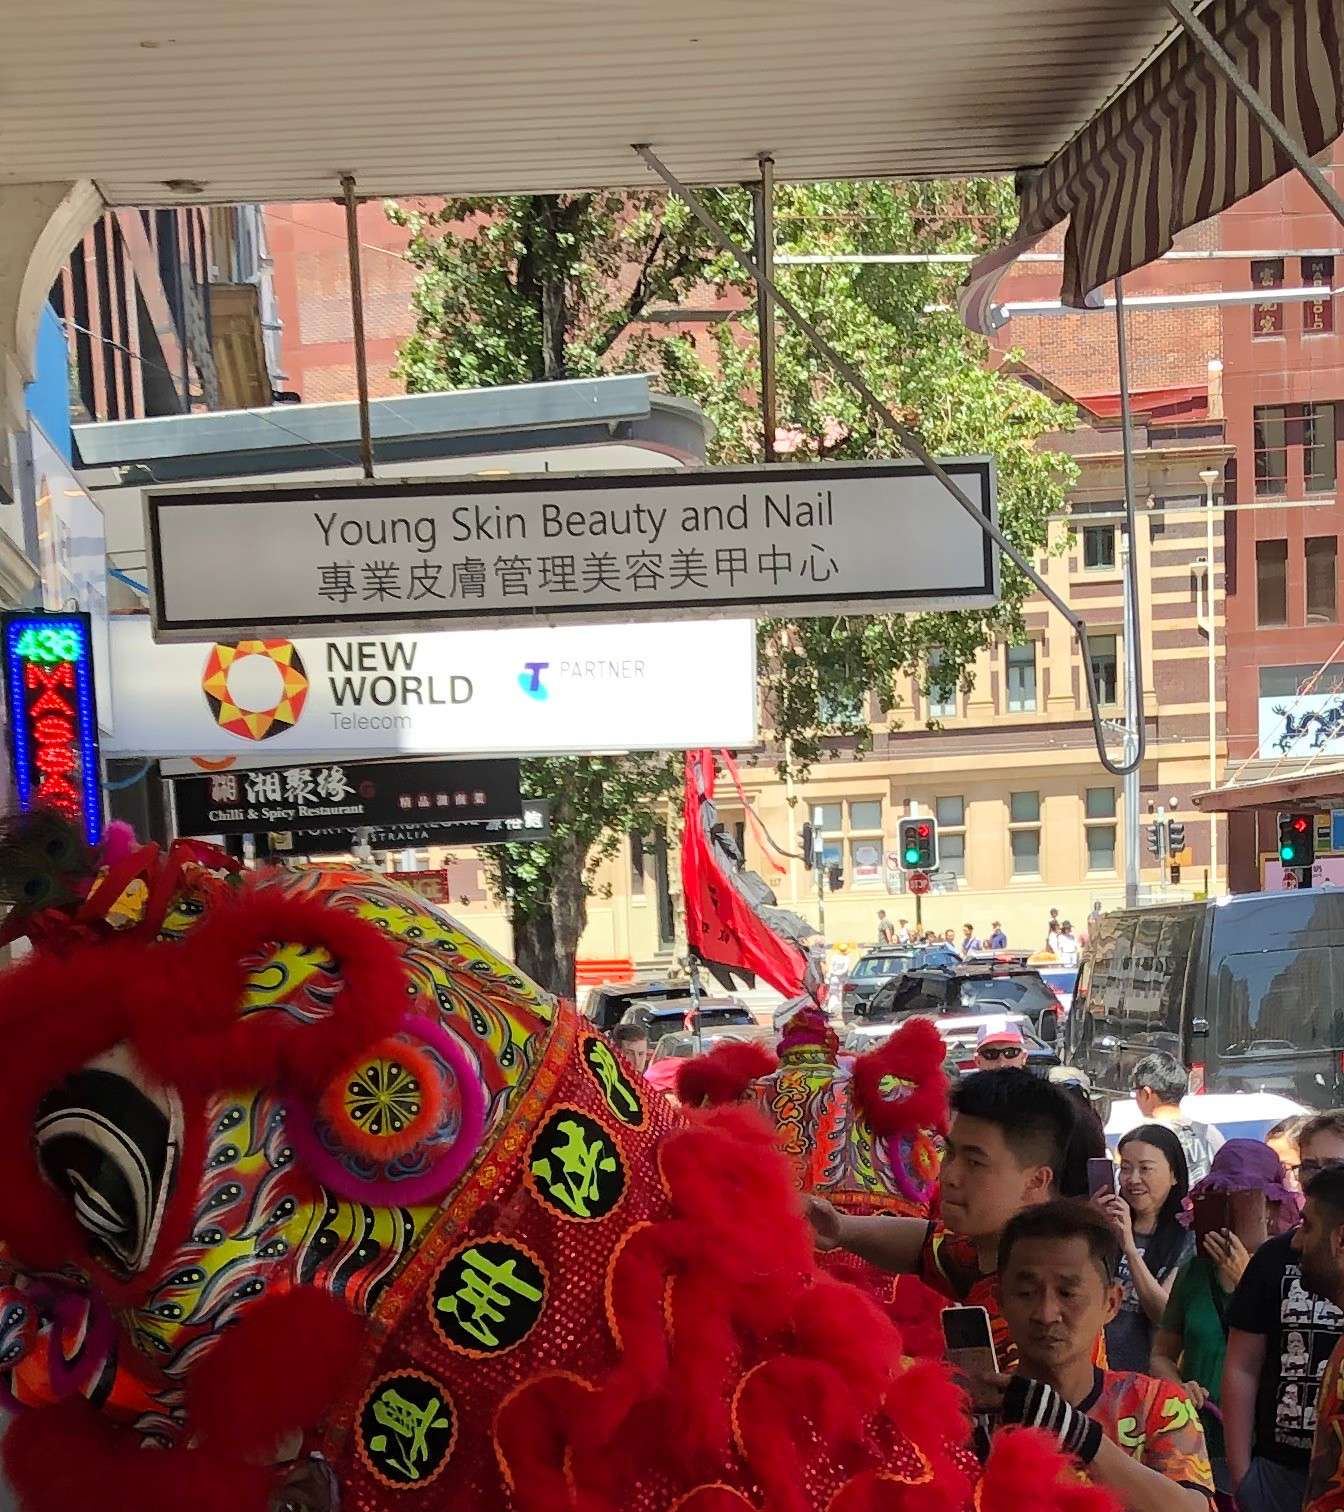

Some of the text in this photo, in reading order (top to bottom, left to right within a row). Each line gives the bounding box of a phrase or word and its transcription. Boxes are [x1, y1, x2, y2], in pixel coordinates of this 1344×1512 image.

[314, 491, 833, 552] Young Skin Beauty and Nail
[317, 542, 838, 602] 專業皮膚管理美容美甲中心
[327, 641, 418, 673] NEW
[560, 660, 645, 679] PARTNER
[328, 675, 474, 707] WORLD
[330, 712, 412, 730] Telecom
[209, 803, 364, 822] Chilli & Spicy Restaurant
